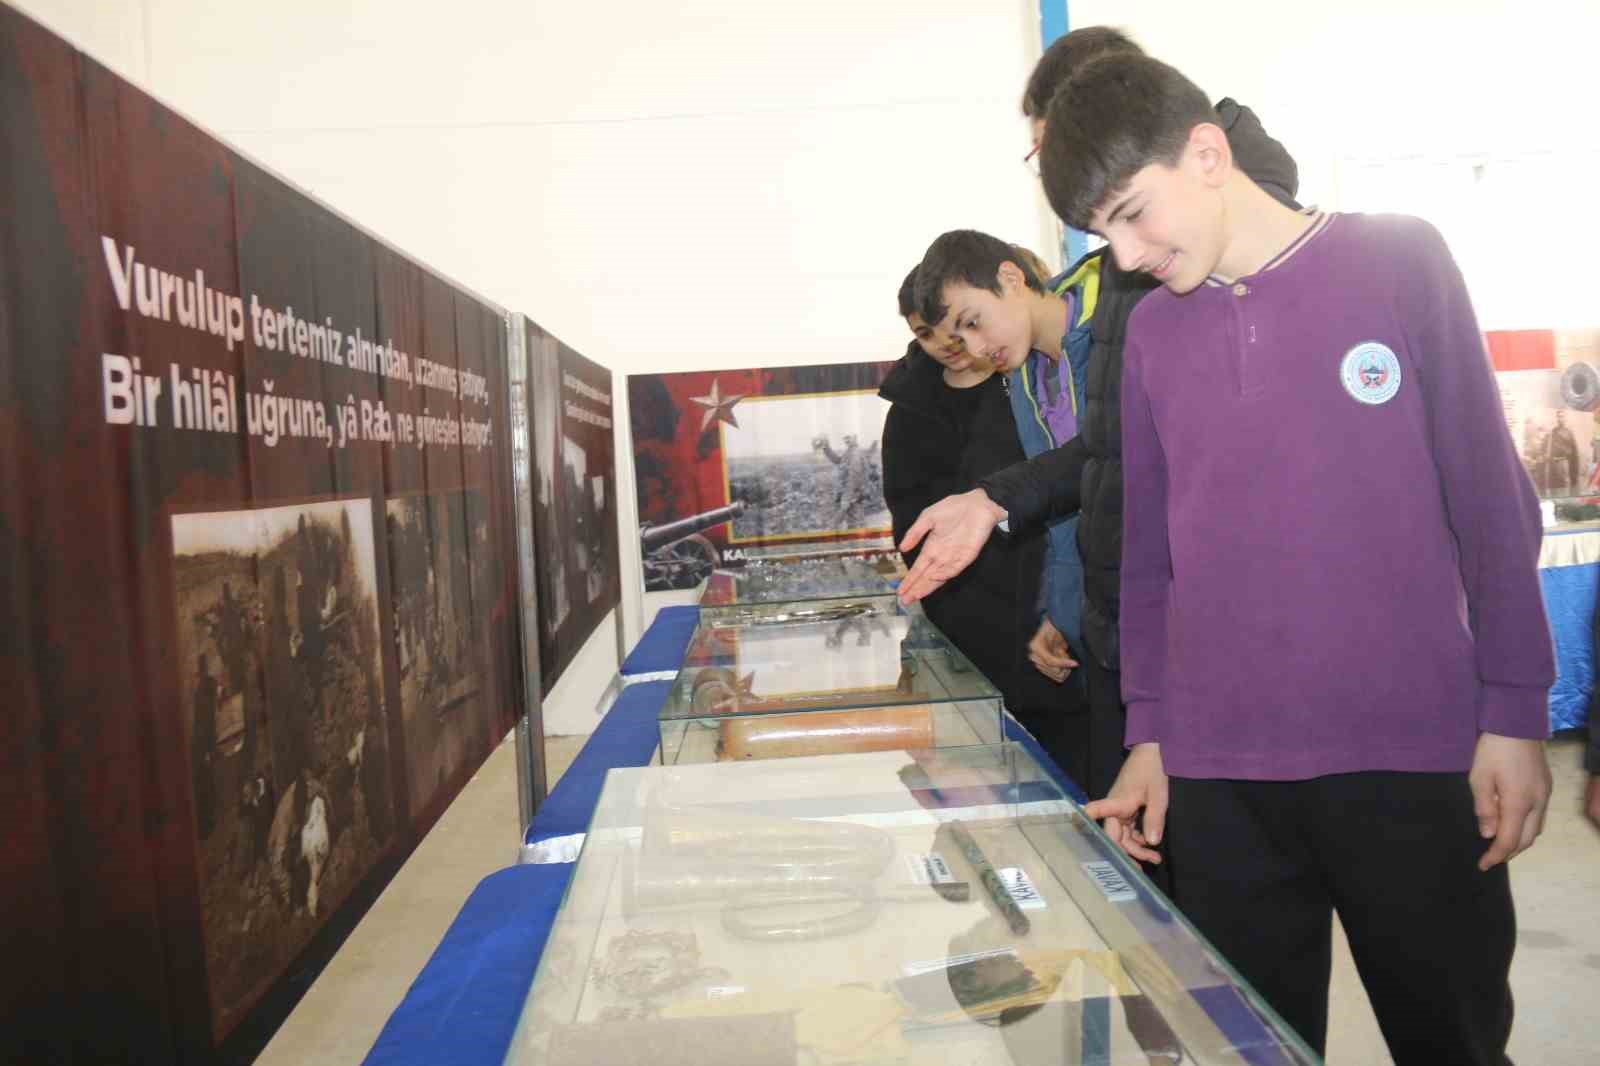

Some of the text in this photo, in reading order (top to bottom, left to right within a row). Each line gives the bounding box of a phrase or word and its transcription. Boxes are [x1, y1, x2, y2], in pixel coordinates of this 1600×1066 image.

[101, 235, 244, 351] Vurulup
[251, 294, 344, 366] tertemiz
[347, 327, 412, 391] alnından,
[101, 353, 162, 427] Bir
[170, 362, 238, 433] hilâl
[246, 379, 334, 448] uğruna,
[336, 394, 358, 448] yâ
[360, 399, 396, 449] Rab,
[397, 412, 414, 444] ne
